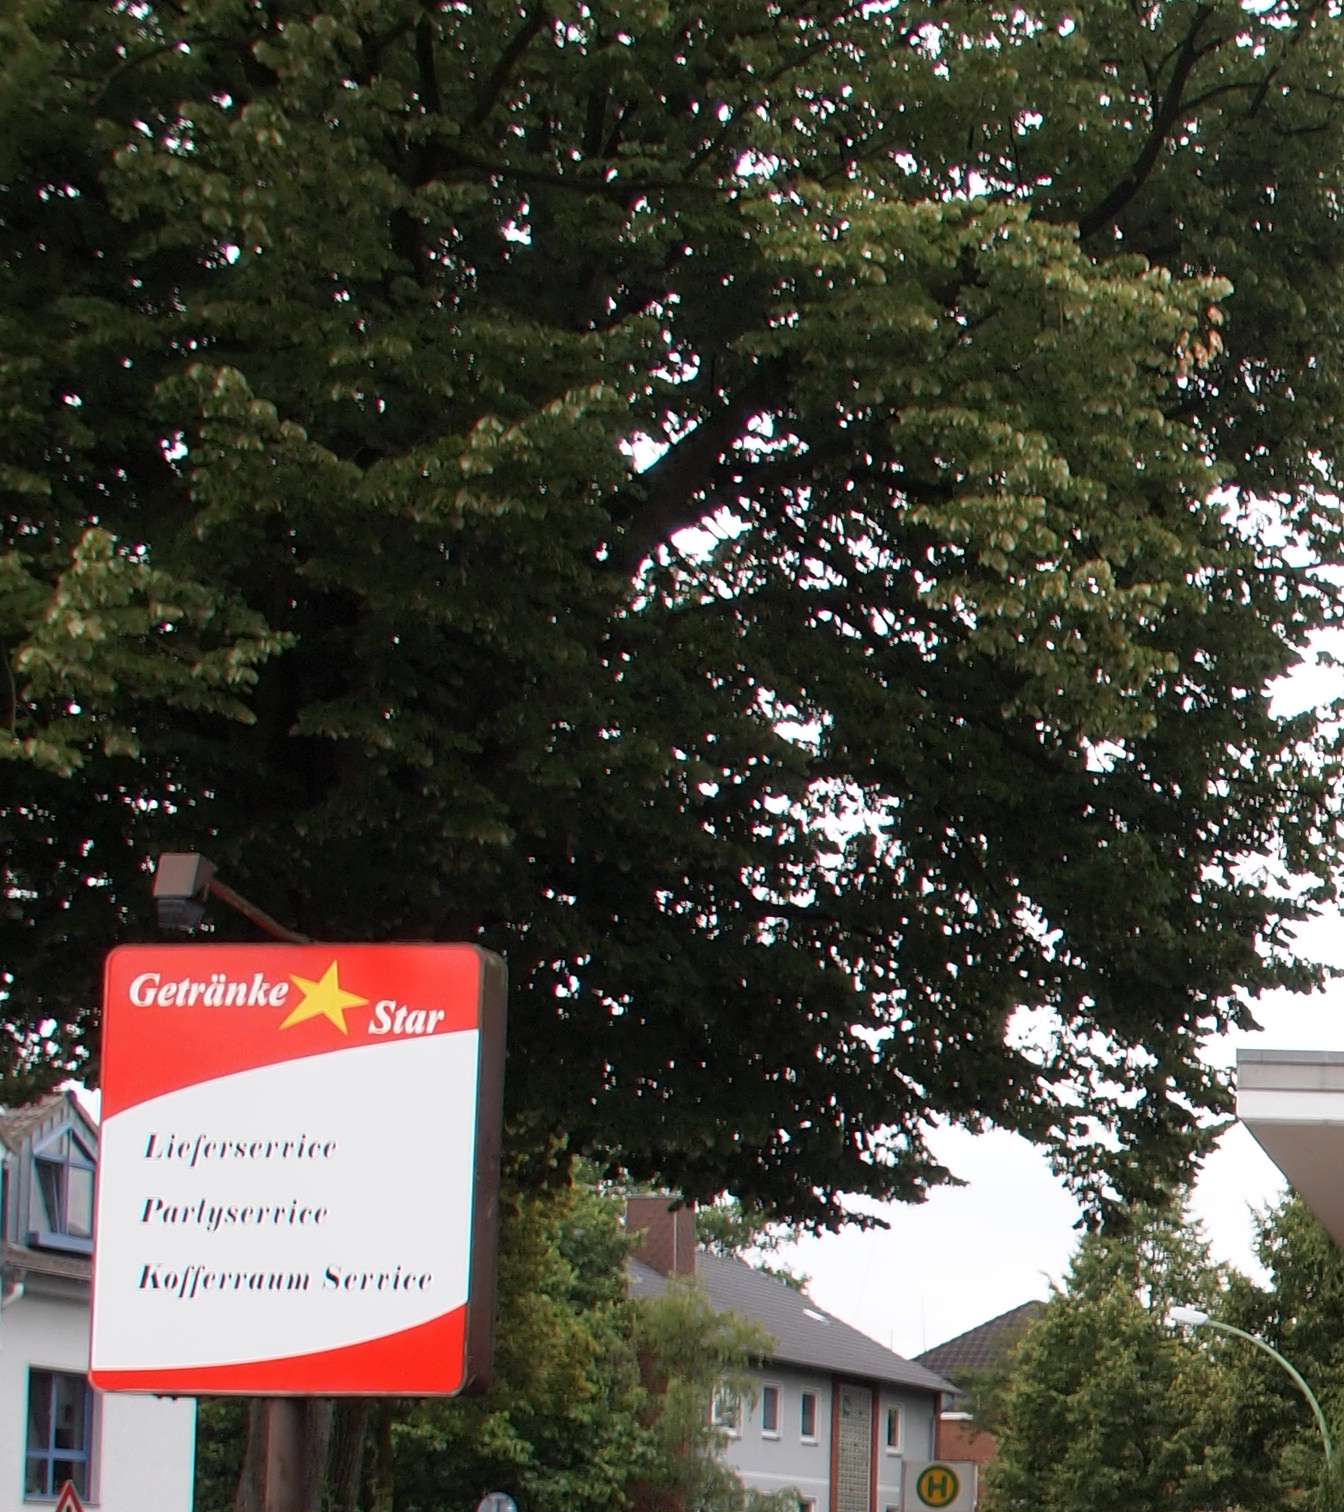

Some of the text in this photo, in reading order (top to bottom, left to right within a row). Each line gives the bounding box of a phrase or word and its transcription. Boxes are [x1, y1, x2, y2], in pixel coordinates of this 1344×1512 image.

[129, 972, 445, 1034] Getränke Star
[144, 1133, 337, 1167] Lieferservice
[141, 1197, 328, 1231] Partyservice
[138, 1264, 433, 1299] Kofferraum Service
[928, 1474, 948, 1499] H
